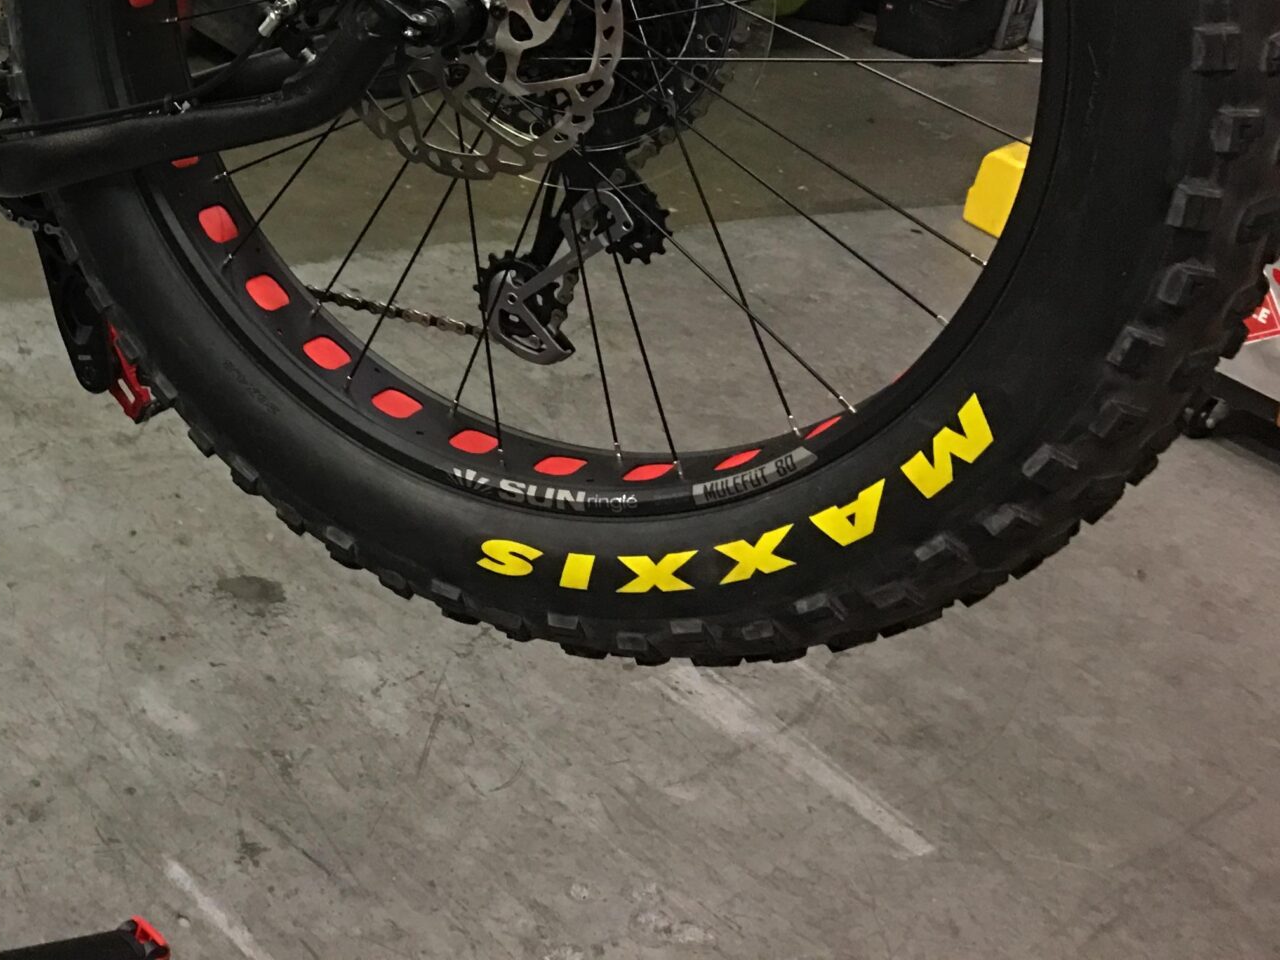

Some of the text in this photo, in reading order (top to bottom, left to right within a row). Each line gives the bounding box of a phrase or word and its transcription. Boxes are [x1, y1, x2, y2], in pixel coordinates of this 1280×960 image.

[476, 392, 994, 594] MAXXIS
[497, 478, 587, 512] SUN
[703, 473, 769, 502] MULEFUT
[776, 454, 797, 476] 80
